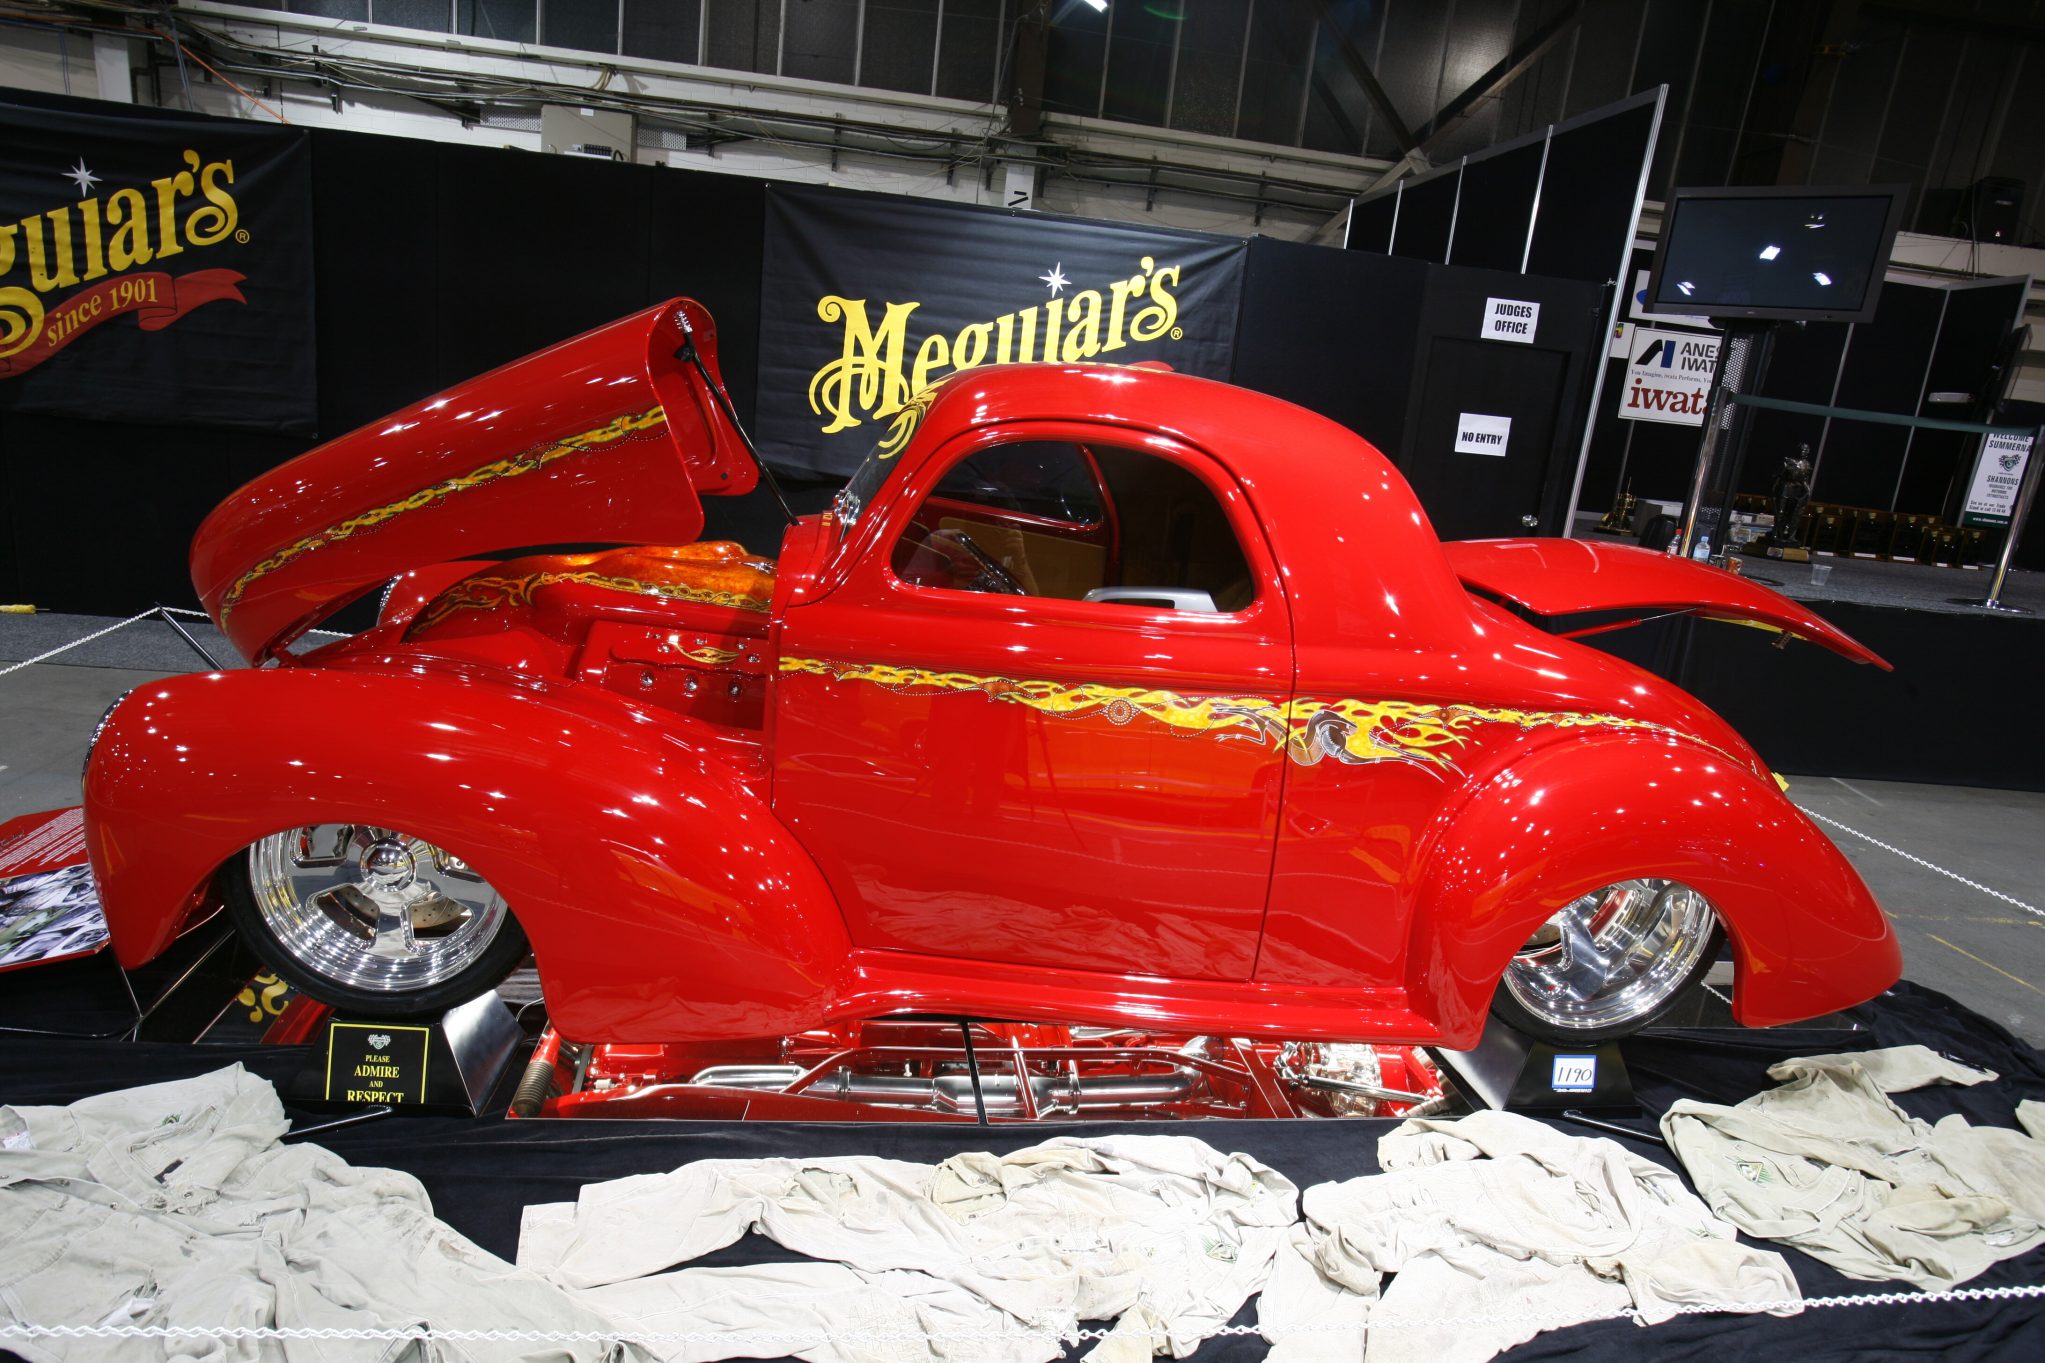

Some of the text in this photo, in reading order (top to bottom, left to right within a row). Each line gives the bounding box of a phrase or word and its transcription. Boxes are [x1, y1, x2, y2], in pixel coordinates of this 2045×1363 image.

[47, 278, 158, 347] since 1901
[1494, 303, 1533, 318] JUDGES
[1494, 320, 1529, 335] OFFICE
[1462, 431, 1503, 445] NO ENTRY
[1987, 475, 2019, 485] SHANNONS
[365, 1054, 391, 1063] PLEASE
[353, 1065, 400, 1078] ADMIRE
[1557, 1066, 1593, 1083] 1190
[369, 1080, 383, 1088] AND
[346, 1089, 404, 1103] RESPECT
